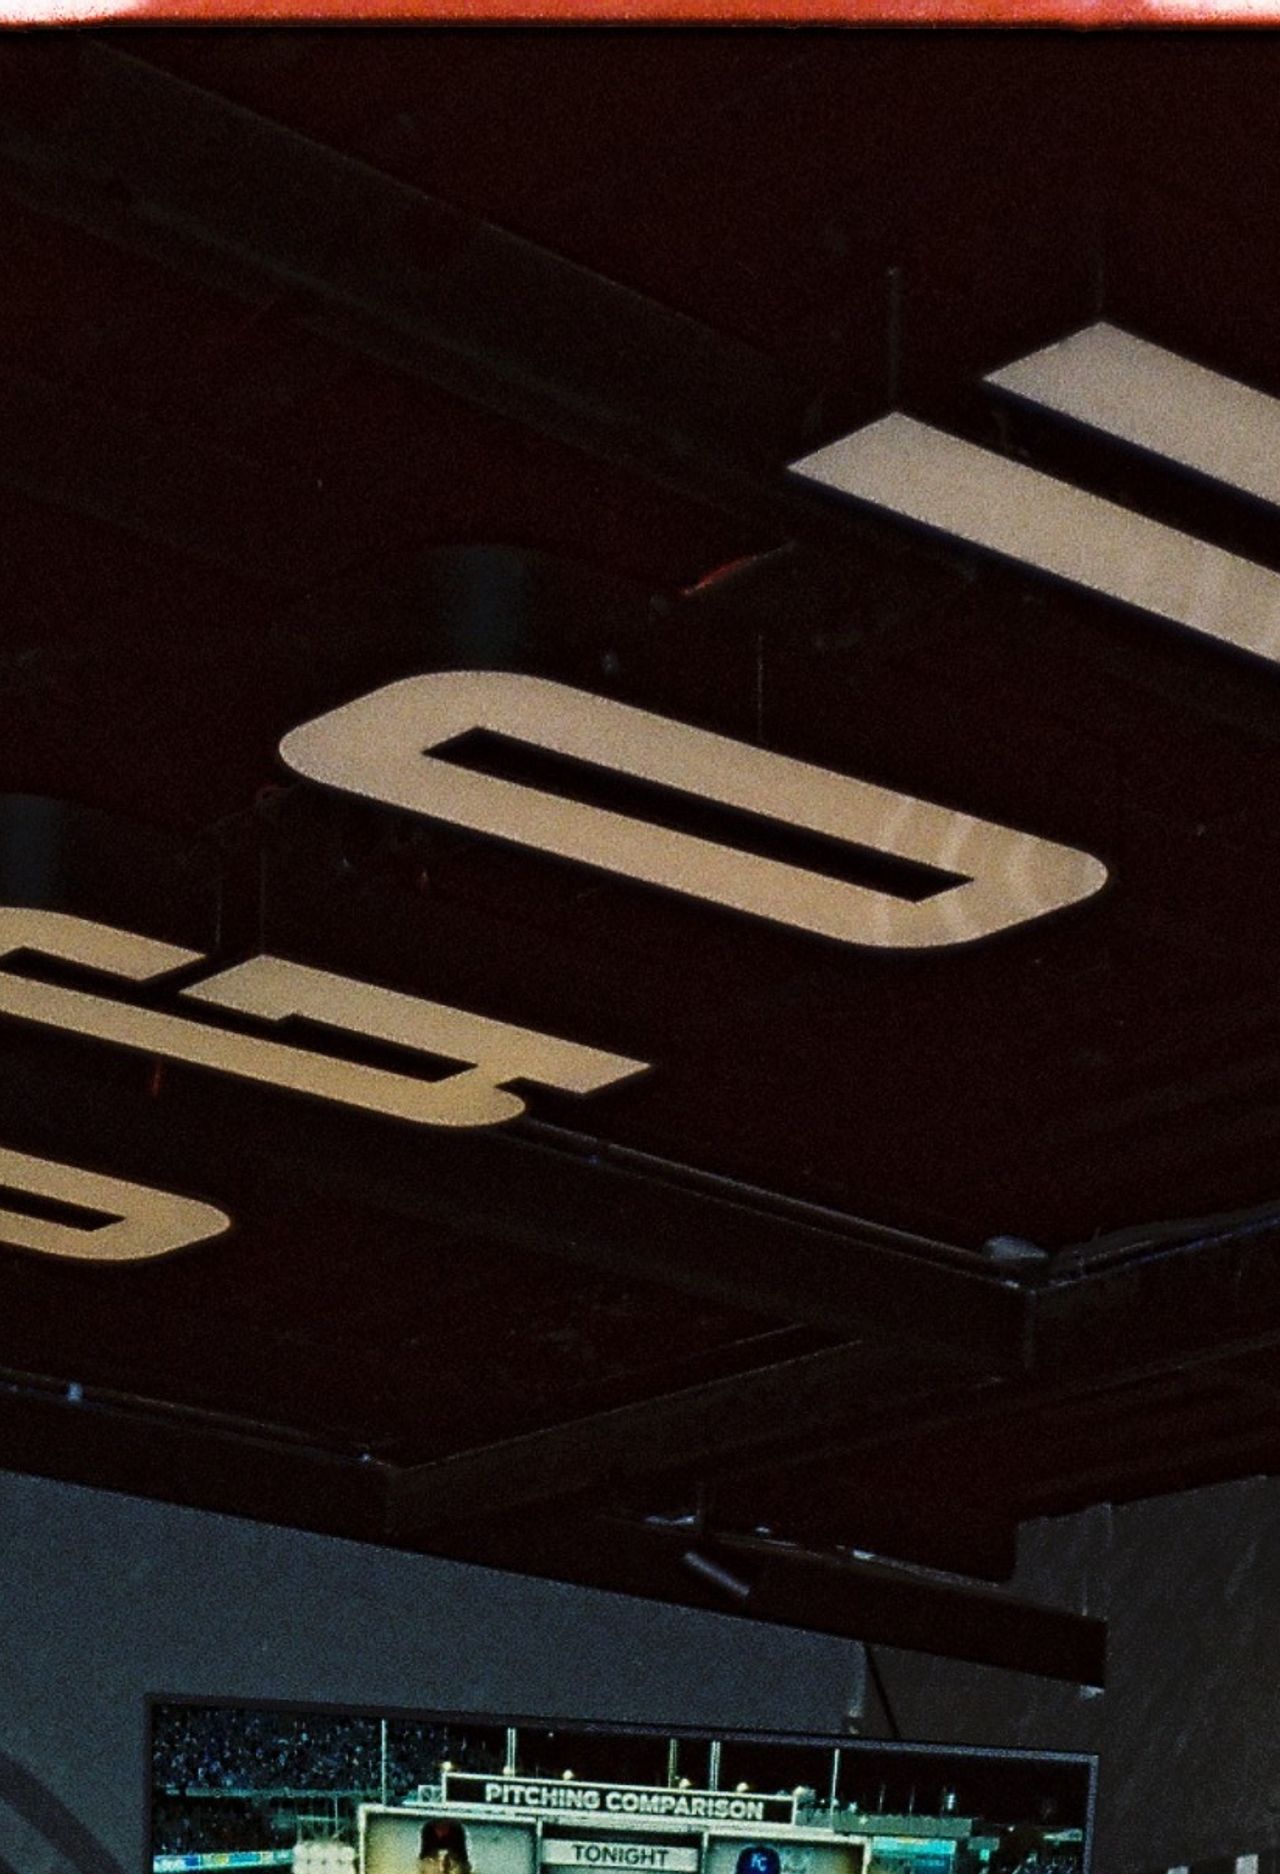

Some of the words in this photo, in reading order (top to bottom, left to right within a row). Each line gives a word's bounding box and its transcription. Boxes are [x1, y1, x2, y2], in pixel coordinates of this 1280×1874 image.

[485, 1783, 600, 1809] PITCHING
[606, 1791, 764, 1820] COMPARISON
[573, 1844, 669, 1867] TONIGHT
